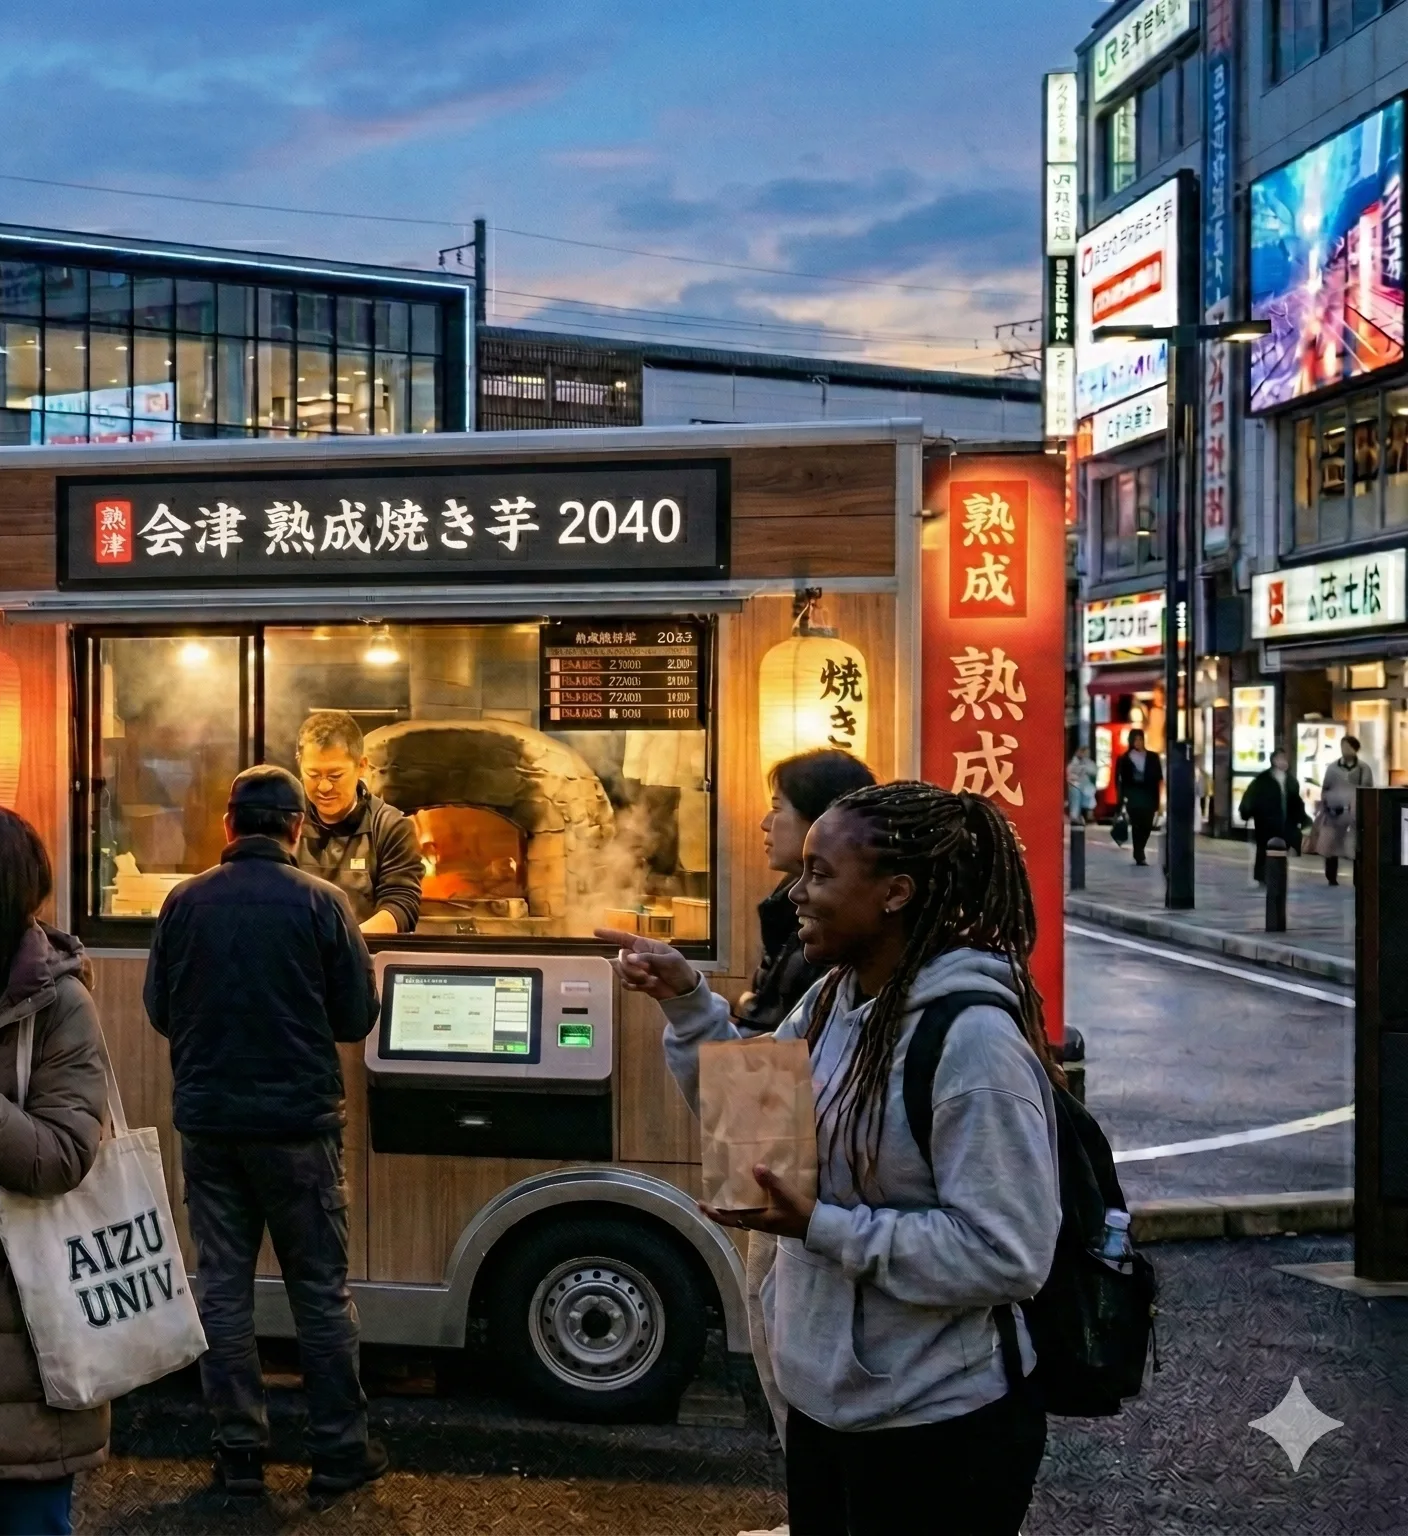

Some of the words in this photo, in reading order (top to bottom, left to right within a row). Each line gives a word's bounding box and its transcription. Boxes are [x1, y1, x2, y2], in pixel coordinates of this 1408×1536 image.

[100, 506, 127, 559] 熟津
[136, 501, 248, 560] 会津
[264, 496, 541, 556] 熟成焼き芋
[558, 498, 682, 545] 2040
[959, 491, 1017, 608] 熟成
[819, 656, 864, 749] 焼き
[947, 645, 1028, 808] 熟成
[64, 1207, 167, 1284] AIZU
